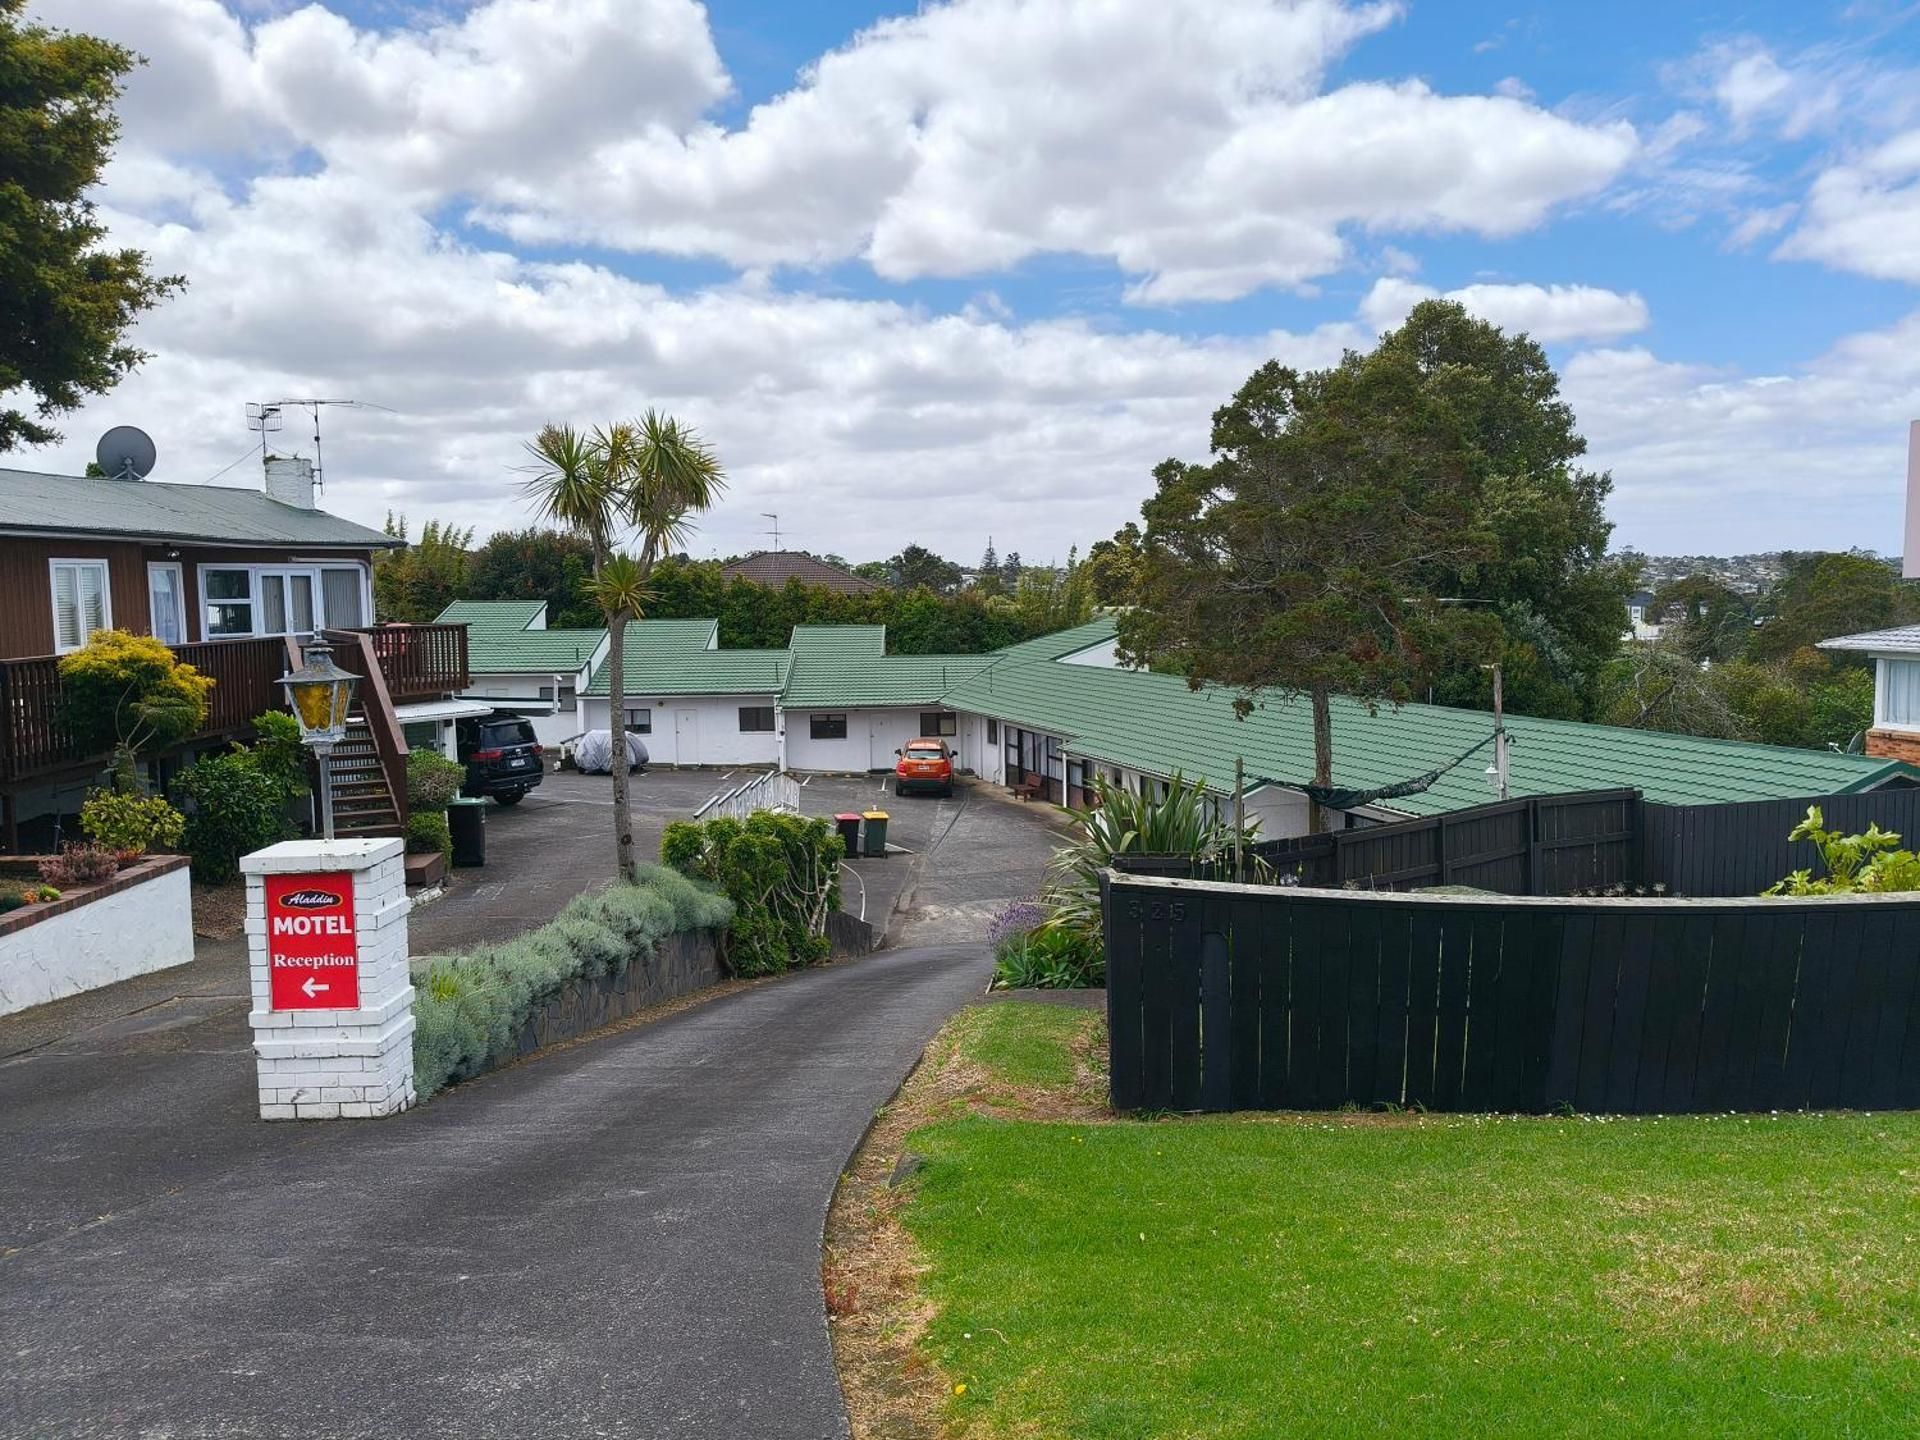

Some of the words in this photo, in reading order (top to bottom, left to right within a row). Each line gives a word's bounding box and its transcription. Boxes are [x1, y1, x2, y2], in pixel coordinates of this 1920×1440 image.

[288, 893, 334, 905] Aladdin
[1128, 900, 1185, 921] 325
[273, 916, 352, 935] MOTEL
[274, 953, 354, 969] Reception
